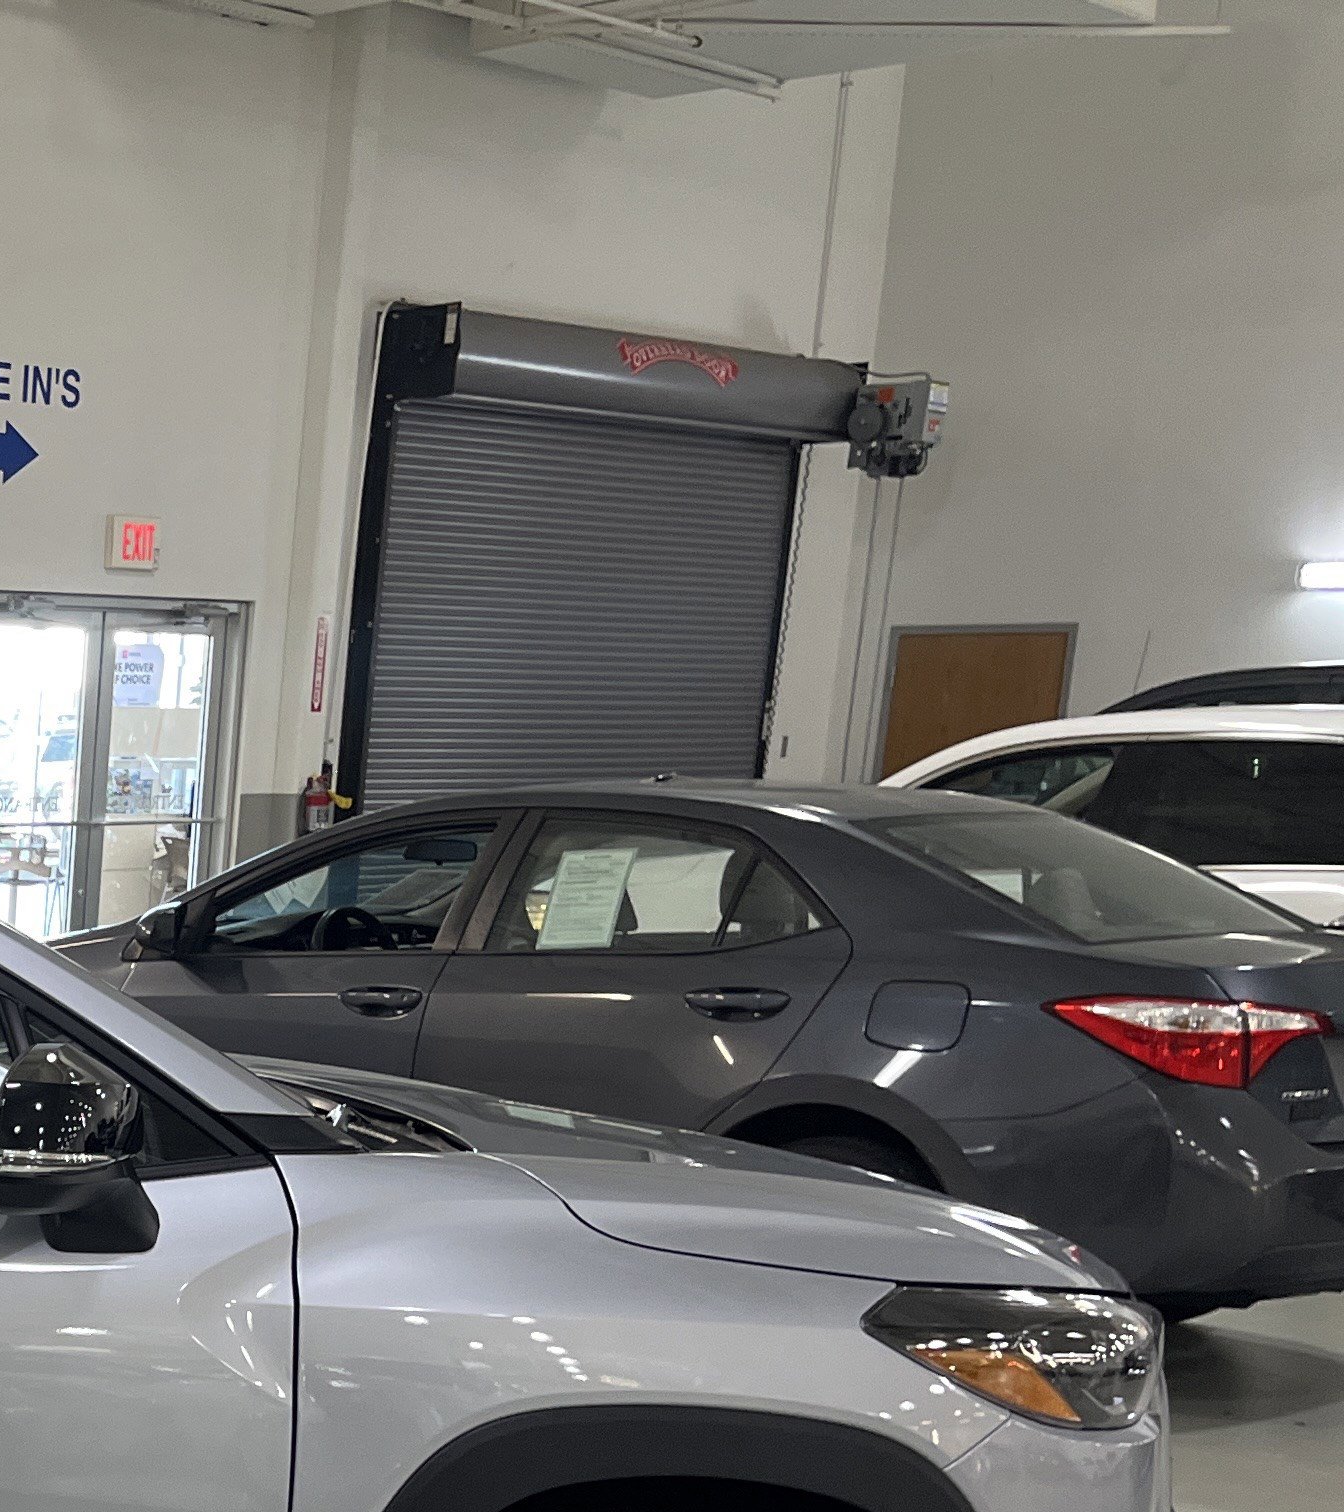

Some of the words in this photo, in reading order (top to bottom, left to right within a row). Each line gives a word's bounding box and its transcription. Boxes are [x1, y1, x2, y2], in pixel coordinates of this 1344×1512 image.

[21, 363, 82, 410] IN'S
[122, 522, 156, 562] EXIT
[120, 674, 152, 685] CHOICE
[124, 662, 155, 673] POWER
